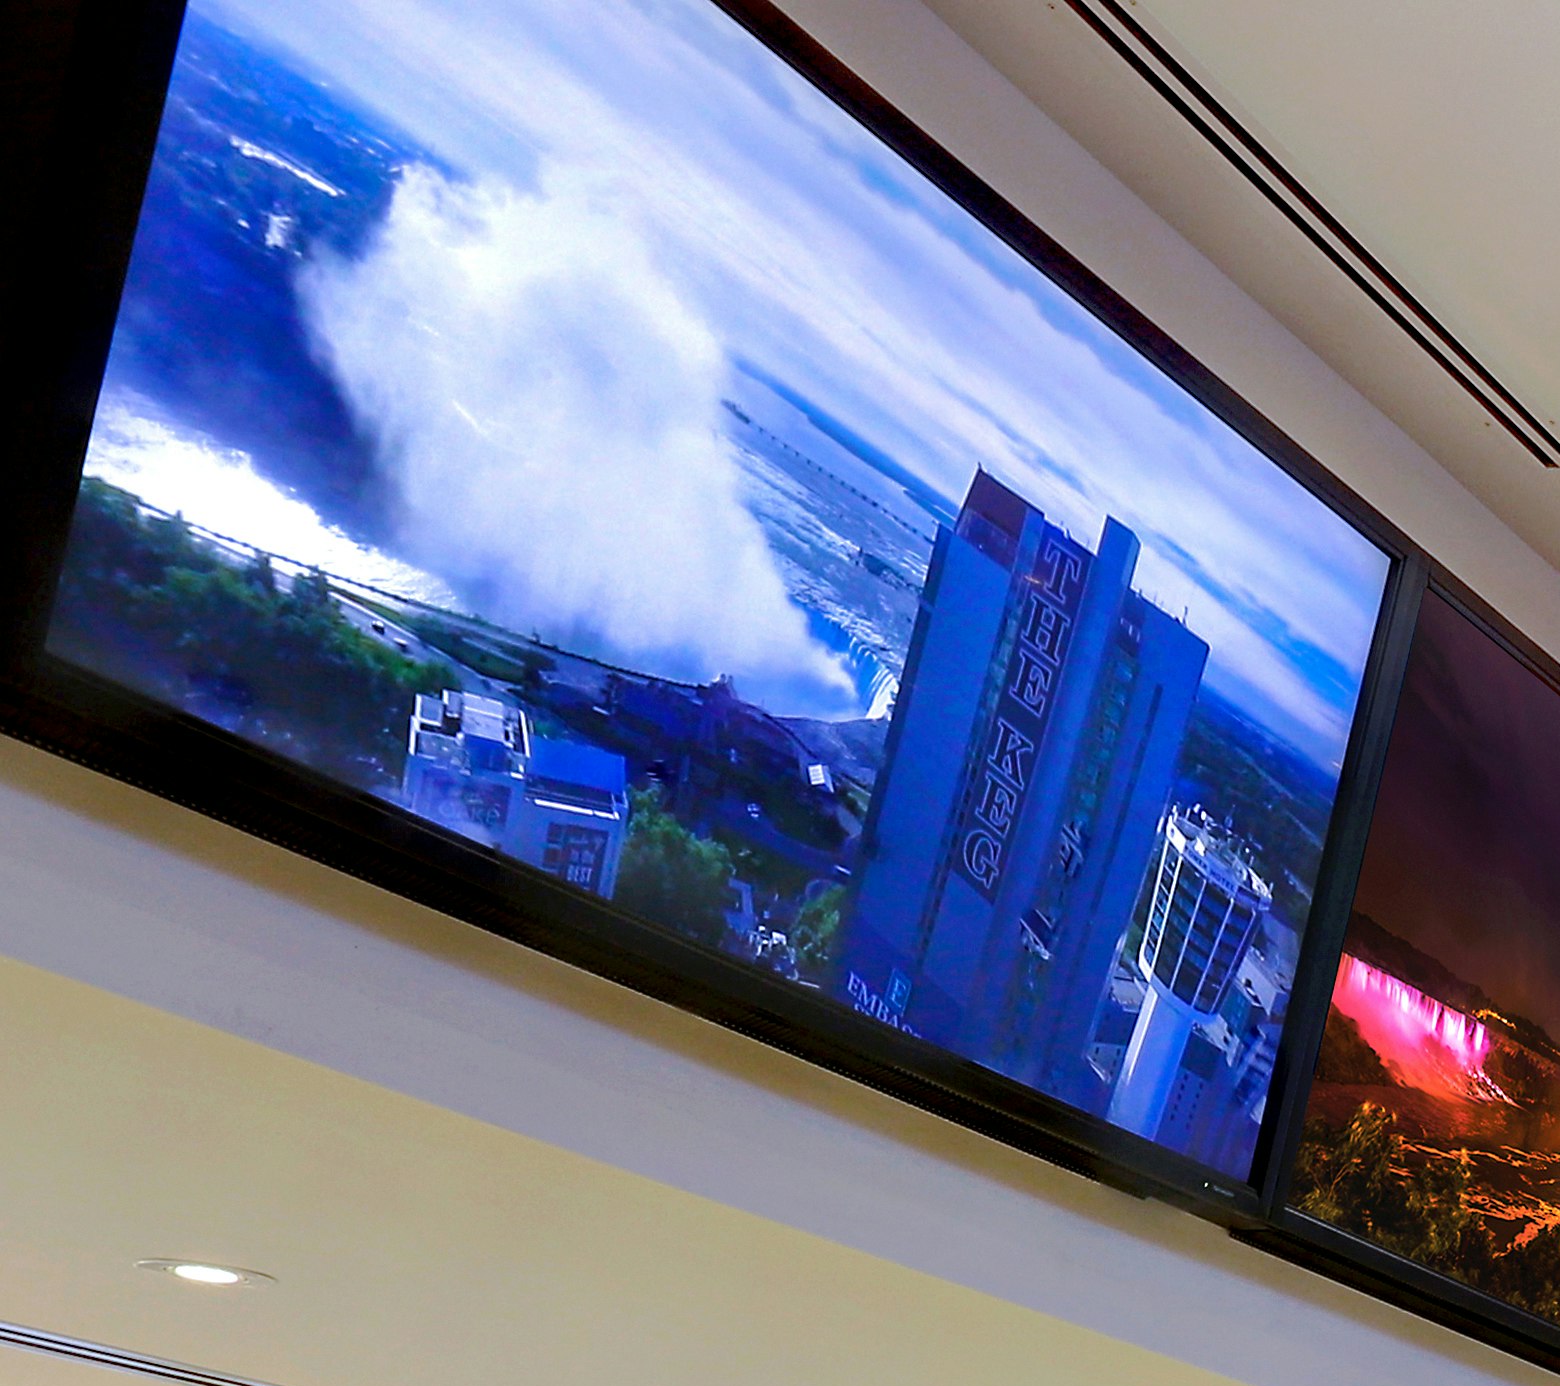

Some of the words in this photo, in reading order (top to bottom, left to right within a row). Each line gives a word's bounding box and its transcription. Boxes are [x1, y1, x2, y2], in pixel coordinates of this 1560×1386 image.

[1010, 539, 1083, 718] THE
[963, 718, 1035, 890] KEG
[847, 970, 922, 1039] EMBA
